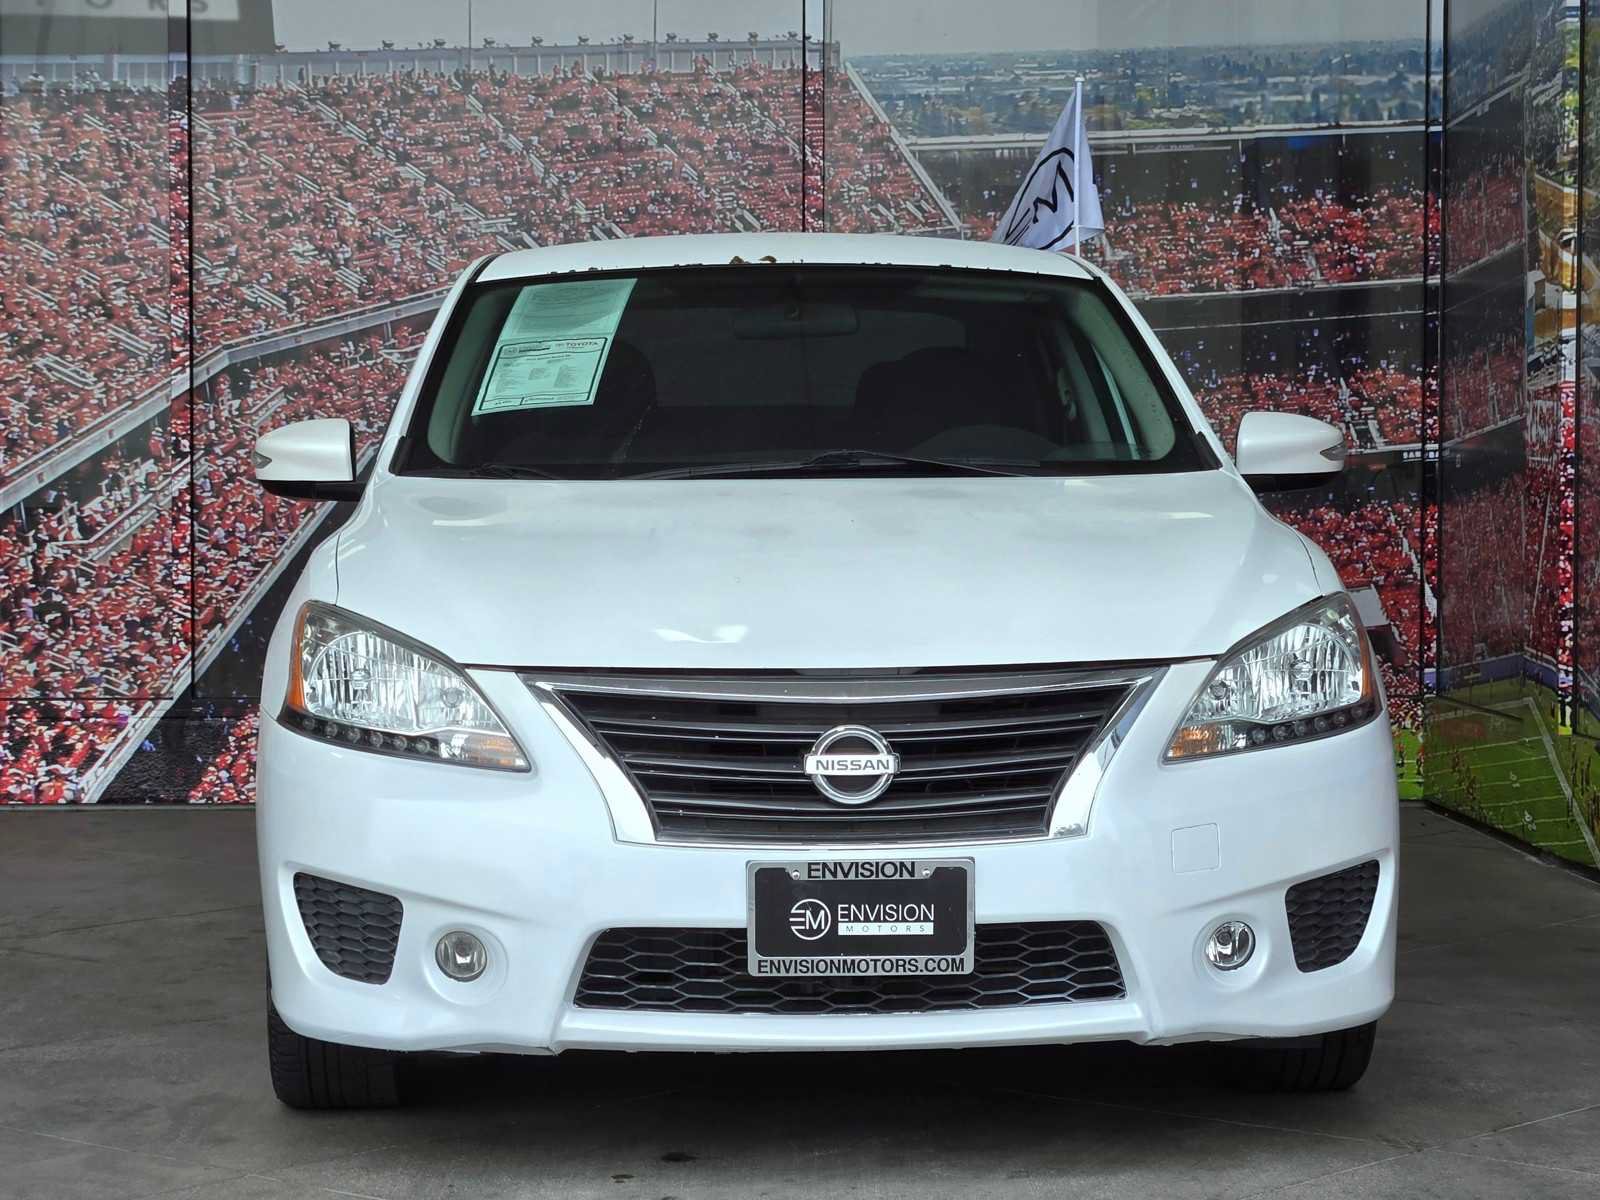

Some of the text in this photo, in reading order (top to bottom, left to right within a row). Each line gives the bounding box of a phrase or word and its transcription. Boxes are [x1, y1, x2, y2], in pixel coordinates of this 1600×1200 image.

[815, 759, 890, 771] NISSAN
[807, 861, 915, 879] ENVISION
[837, 903, 935, 922] ENVISION
[846, 924, 925, 933] MOTORS
[757, 957, 965, 975] ENVISIONMOTORS.COM
